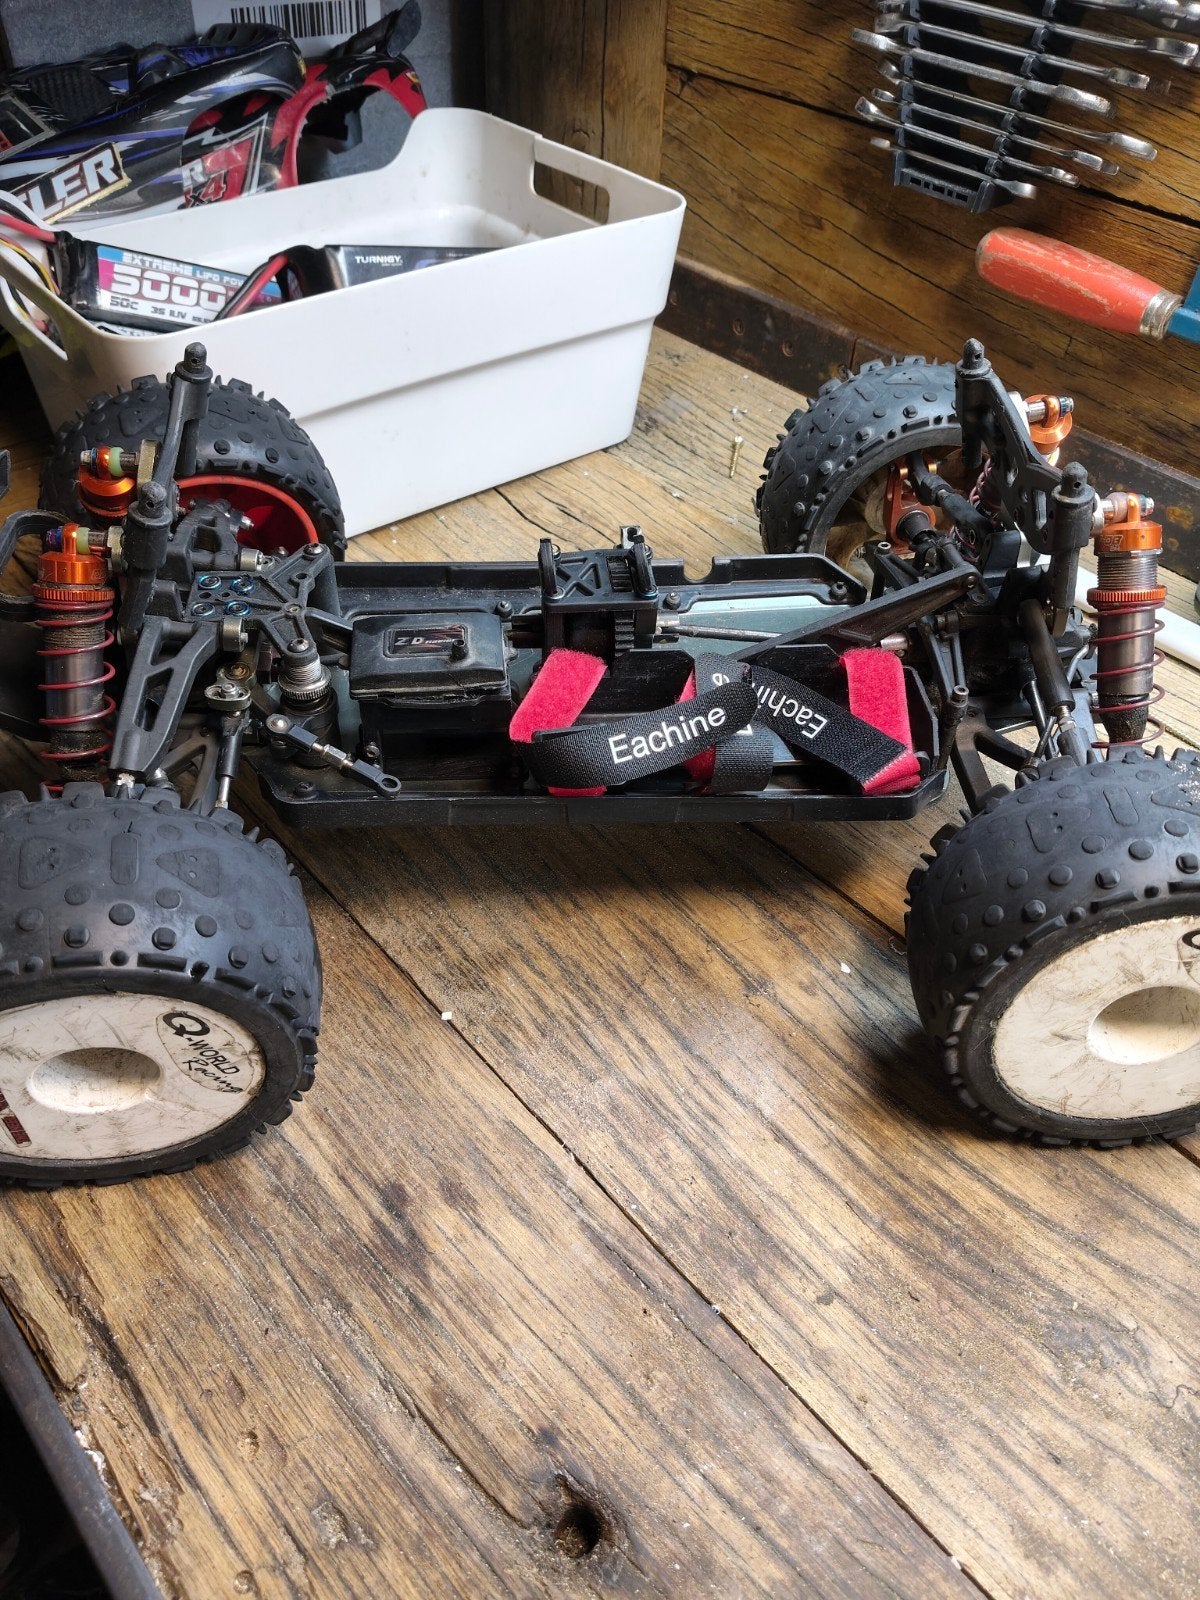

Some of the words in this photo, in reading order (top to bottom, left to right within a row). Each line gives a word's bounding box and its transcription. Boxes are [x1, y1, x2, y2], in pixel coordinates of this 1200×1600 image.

[15, 149, 120, 219] LER
[122, 252, 193, 276] EXTREME
[355, 255, 402, 264] TURNIGY
[110, 263, 227, 313] 5000
[608, 707, 726, 764] Eachine
